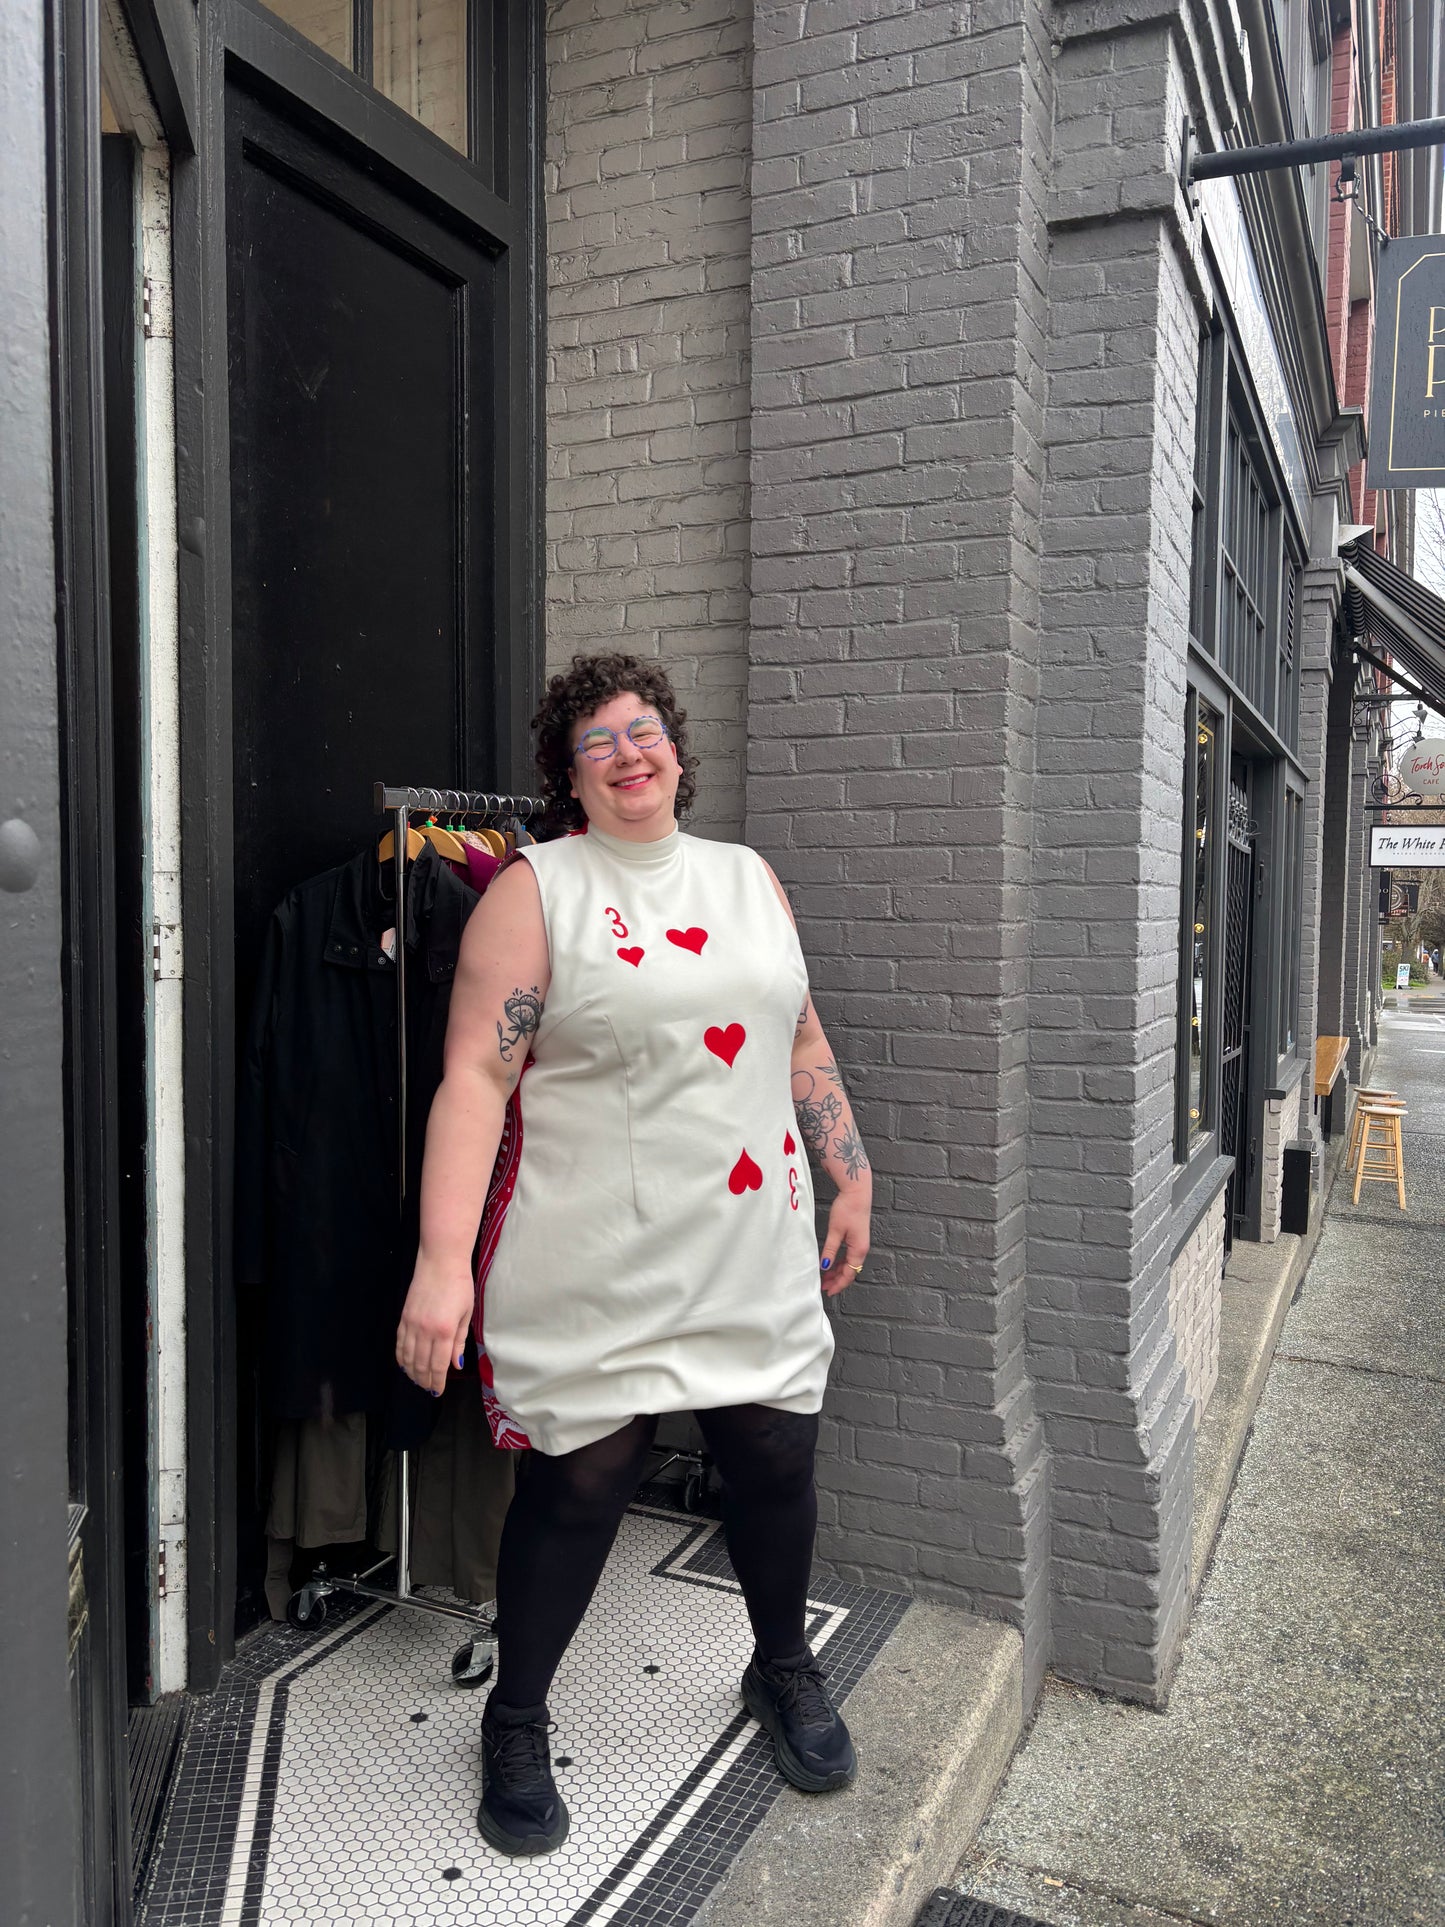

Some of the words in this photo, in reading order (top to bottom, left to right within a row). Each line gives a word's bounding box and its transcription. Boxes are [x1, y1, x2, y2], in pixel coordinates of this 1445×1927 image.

[1411, 756, 1432, 774] Torch
[1378, 837, 1399, 849] The
[1402, 837, 1436, 849] White
[604, 906, 629, 939] 3
